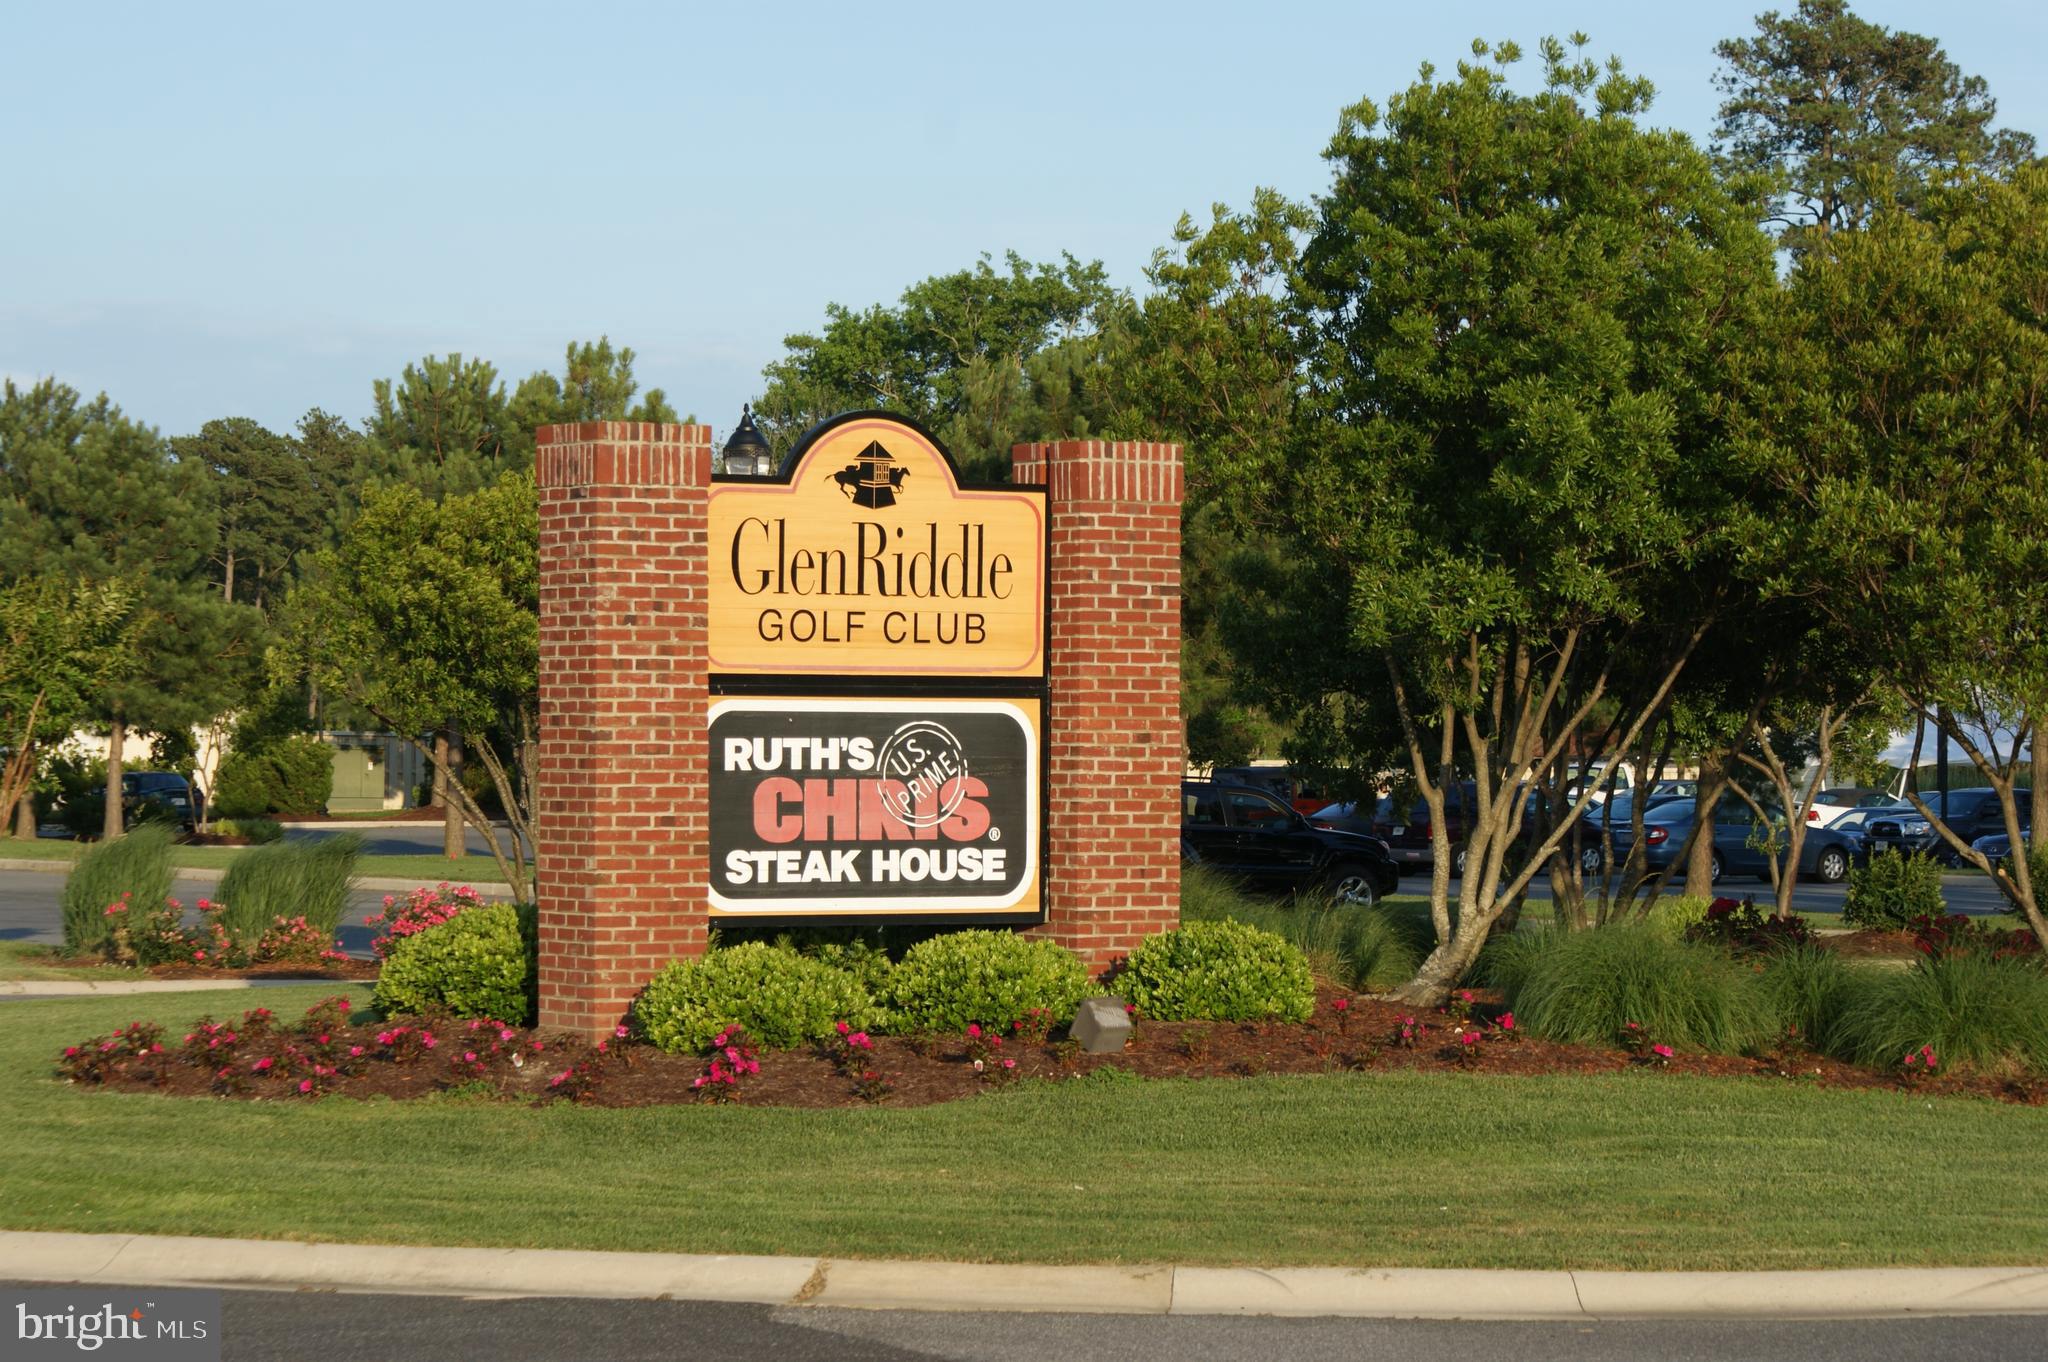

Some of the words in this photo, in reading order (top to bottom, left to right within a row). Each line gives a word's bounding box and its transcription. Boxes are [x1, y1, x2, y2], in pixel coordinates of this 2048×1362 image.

[731, 517, 1013, 599] GlenRiddle
[758, 609, 866, 642] GOLF
[883, 612, 986, 644] CLUB
[724, 737, 875, 771] RUTH'S
[897, 751, 957, 813] PRIME
[753, 776, 991, 843] CHRIS
[725, 849, 863, 884] STEAK
[872, 848, 1006, 882] HOUSE
